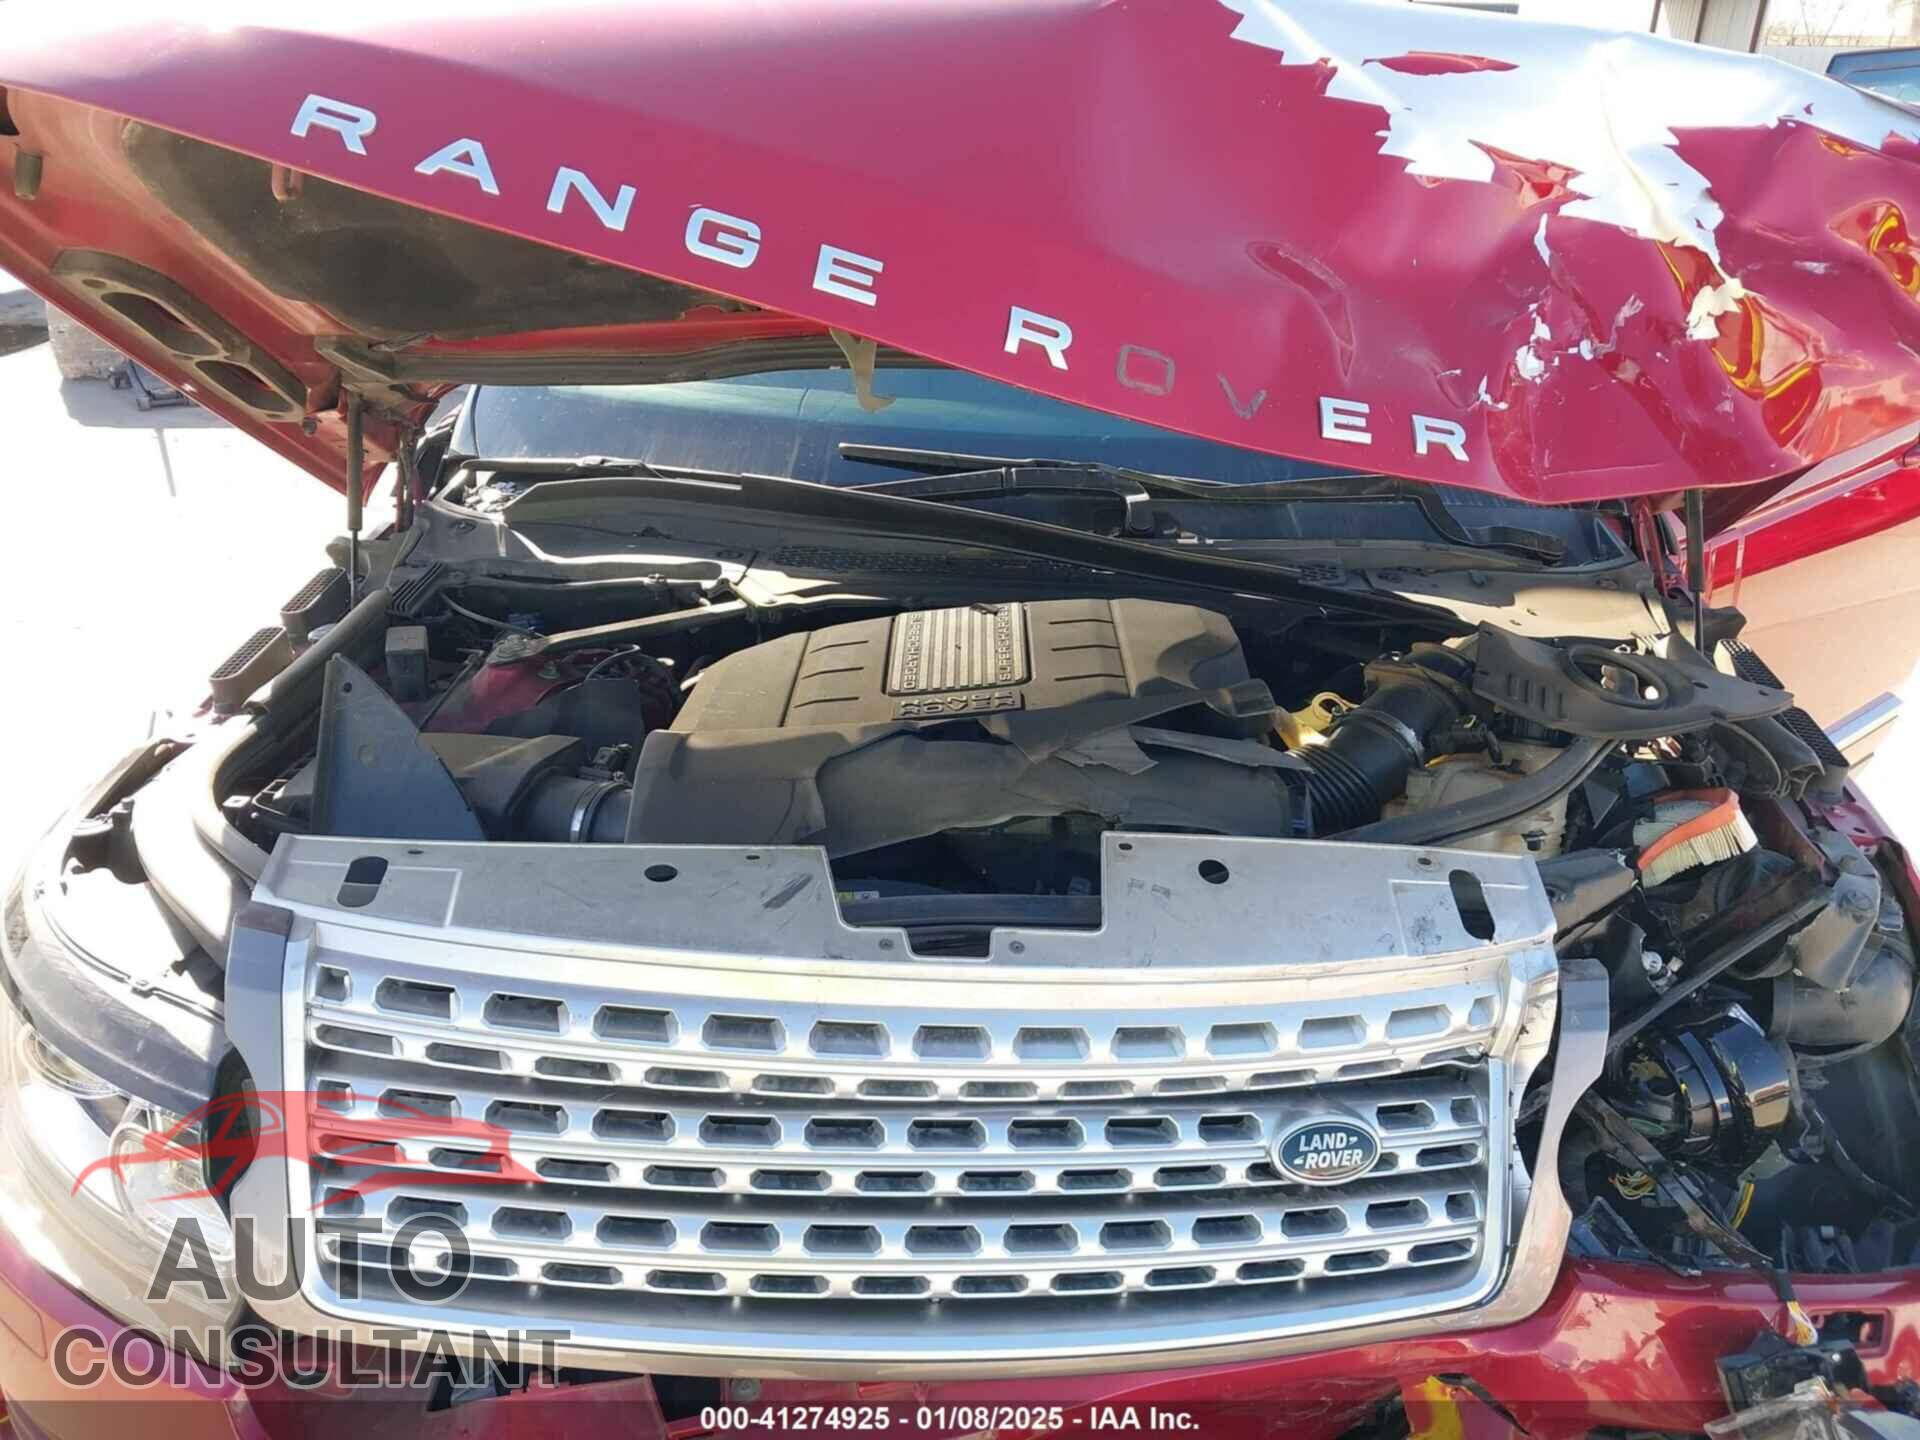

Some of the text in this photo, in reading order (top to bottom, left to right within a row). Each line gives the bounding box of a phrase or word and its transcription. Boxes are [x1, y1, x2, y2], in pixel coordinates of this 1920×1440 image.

[291, 93, 1470, 462] RANGE ROVER
[1299, 1132, 1347, 1152] LAND
[1305, 1149, 1363, 1169] ROVER
